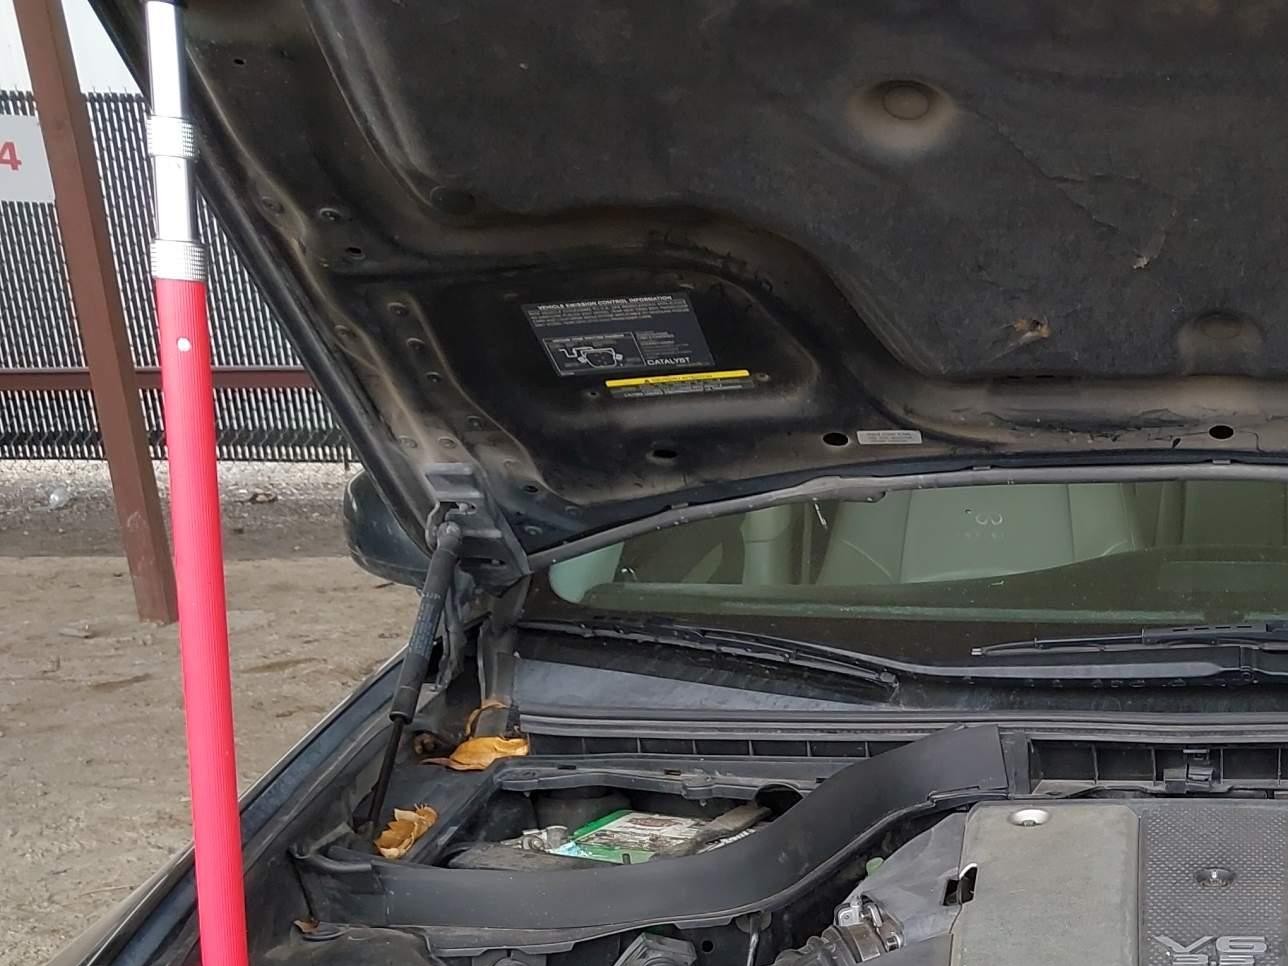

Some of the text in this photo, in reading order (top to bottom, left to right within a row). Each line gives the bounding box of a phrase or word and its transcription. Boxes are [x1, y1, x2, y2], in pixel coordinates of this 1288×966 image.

[647, 356, 691, 366] CATALYST
[1152, 935, 1268, 953] V6
[1172, 954, 1255, 965] 3.5
